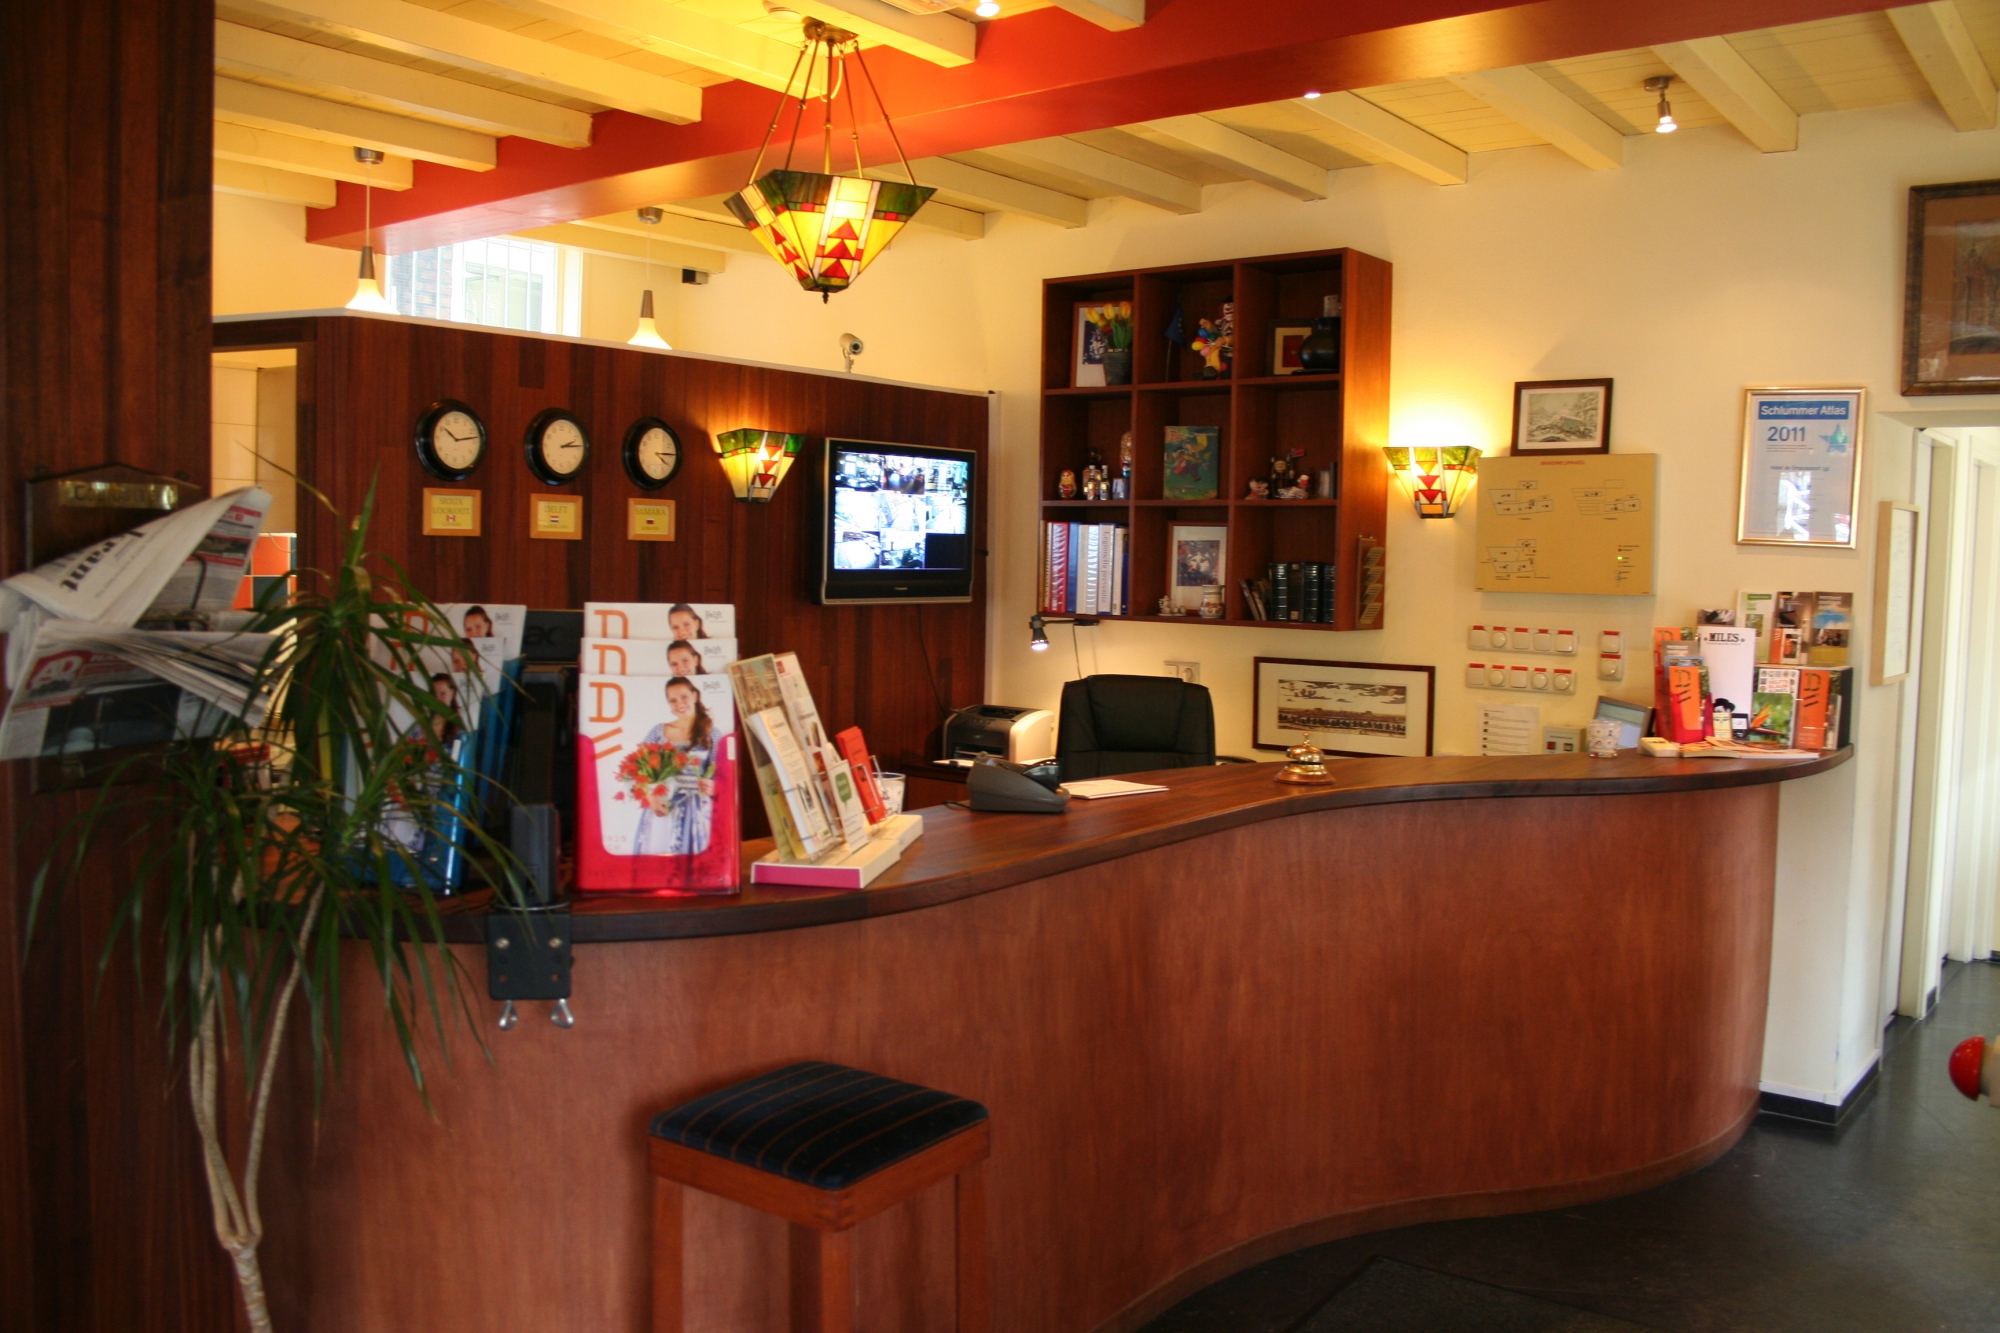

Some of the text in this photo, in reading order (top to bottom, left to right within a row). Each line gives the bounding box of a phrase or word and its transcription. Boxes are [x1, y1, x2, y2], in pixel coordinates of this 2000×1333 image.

[1761, 405, 1846, 415] Schlummer Atlas
[1767, 426, 1806, 442] 2011
[544, 505, 568, 514] DELFT
[1708, 632, 1740, 643] MILES
